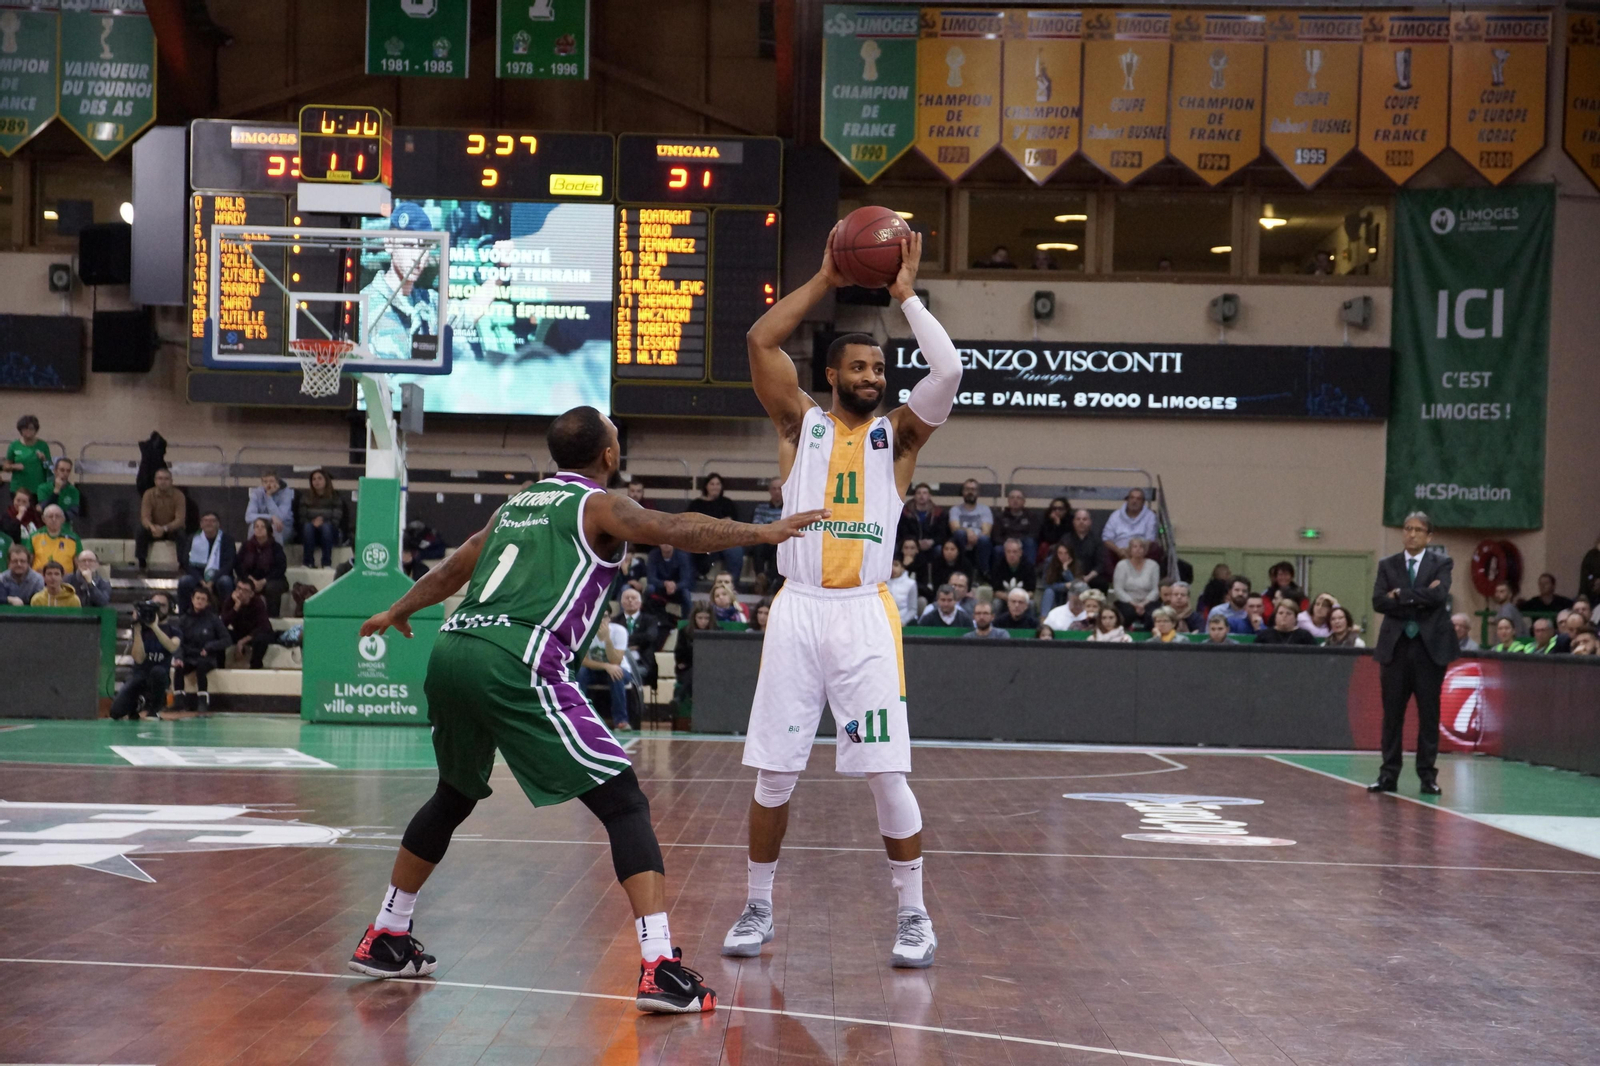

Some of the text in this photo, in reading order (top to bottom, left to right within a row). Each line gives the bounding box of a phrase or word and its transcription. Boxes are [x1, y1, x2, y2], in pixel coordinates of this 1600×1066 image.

[856, 17, 918, 32] LIMOGES
[941, 17, 1002, 32] LIMOGES
[1029, 19, 1081, 33] LIMOGE
[1117, 20, 1169, 34] LIMOGE
[1206, 21, 1266, 35] LIMOGES
[1300, 22, 1362, 36] LIMOGES
[1390, 22, 1450, 37] LIMOGES
[1486, 22, 1548, 36] LIMOGES
[64, 61, 150, 79] VAINQUEUR
[380, 58, 410, 72] 1981
[423, 60, 453, 73] 1985
[506, 62, 534, 74] 1978
[551, 63, 578, 75] 1996
[62, 80, 153, 98] DU TOURNOI
[832, 84, 909, 100] CHAMPION
[918, 94, 993, 108] CHAMPION
[1178, 96, 1256, 110] CHAMPION
[1384, 96, 1420, 109] COUPE
[1480, 90, 1517, 104] COUPE
[79, 99, 134, 116] DES AS
[861, 105, 881, 118] DE
[1004, 106, 1080, 120] CHAMPION
[946, 110, 963, 122] DE
[1207, 113, 1225, 125] DE
[1392, 114, 1409, 126] DE
[230, 131, 297, 145] LIMOGES
[842, 123, 897, 138] FRANCE
[928, 125, 982, 138] FRANCE
[1127, 125, 1168, 140] BUSNEL
[1189, 127, 1242, 141] FRANCE
[1374, 129, 1428, 142] FRANCE
[656, 144, 721, 158] UNICAJA
[854, 145, 884, 160] 1990
[1296, 149, 1325, 164] 1995
[552, 177, 601, 192] Bodet
[215, 197, 245, 211] INGLIS
[196, 211, 247, 225] 1 HARDY
[620, 209, 692, 224] 1 BOATRIGHT
[1460, 207, 1519, 220] LIMOGES
[619, 223, 628, 237] 2
[195, 239, 207, 252] 11
[619, 237, 696, 253] 3 FERNANDEZ
[450, 247, 550, 264] MA VOLONTÉ
[620, 251, 633, 265] 10
[449, 265, 591, 283] EST TOUT TERRAIN
[619, 266, 661, 280] 11 DIEZ
[449, 284, 548, 299] MON AVENIR
[220, 296, 252, 310] OWARD
[220, 310, 265, 325] OUTEILLE
[516, 302, 591, 320] ÉPREUVE.
[617, 308, 631, 321] 21
[1437, 288, 1505, 339] ICI
[617, 322, 682, 337] 22 ROBERTS
[637, 336, 681, 351] LESSORT
[617, 350, 632, 364] 33
[896, 347, 1183, 374] LOENZO VISCONTI
[1442, 372, 1492, 388] C'EST
[1074, 392, 1141, 408] 87000
[1148, 393, 1237, 410] LIMOGES
[1421, 404, 1500, 420] LIMOGES
[833, 471, 859, 504] 11
[1415, 483, 1511, 500] #CSPnation
[366, 548, 387, 563] CSP
[479, 543, 520, 604] 1
[334, 683, 409, 698] LIMOGES
[324, 700, 418, 717] ville sportive
[864, 709, 890, 743] 11
